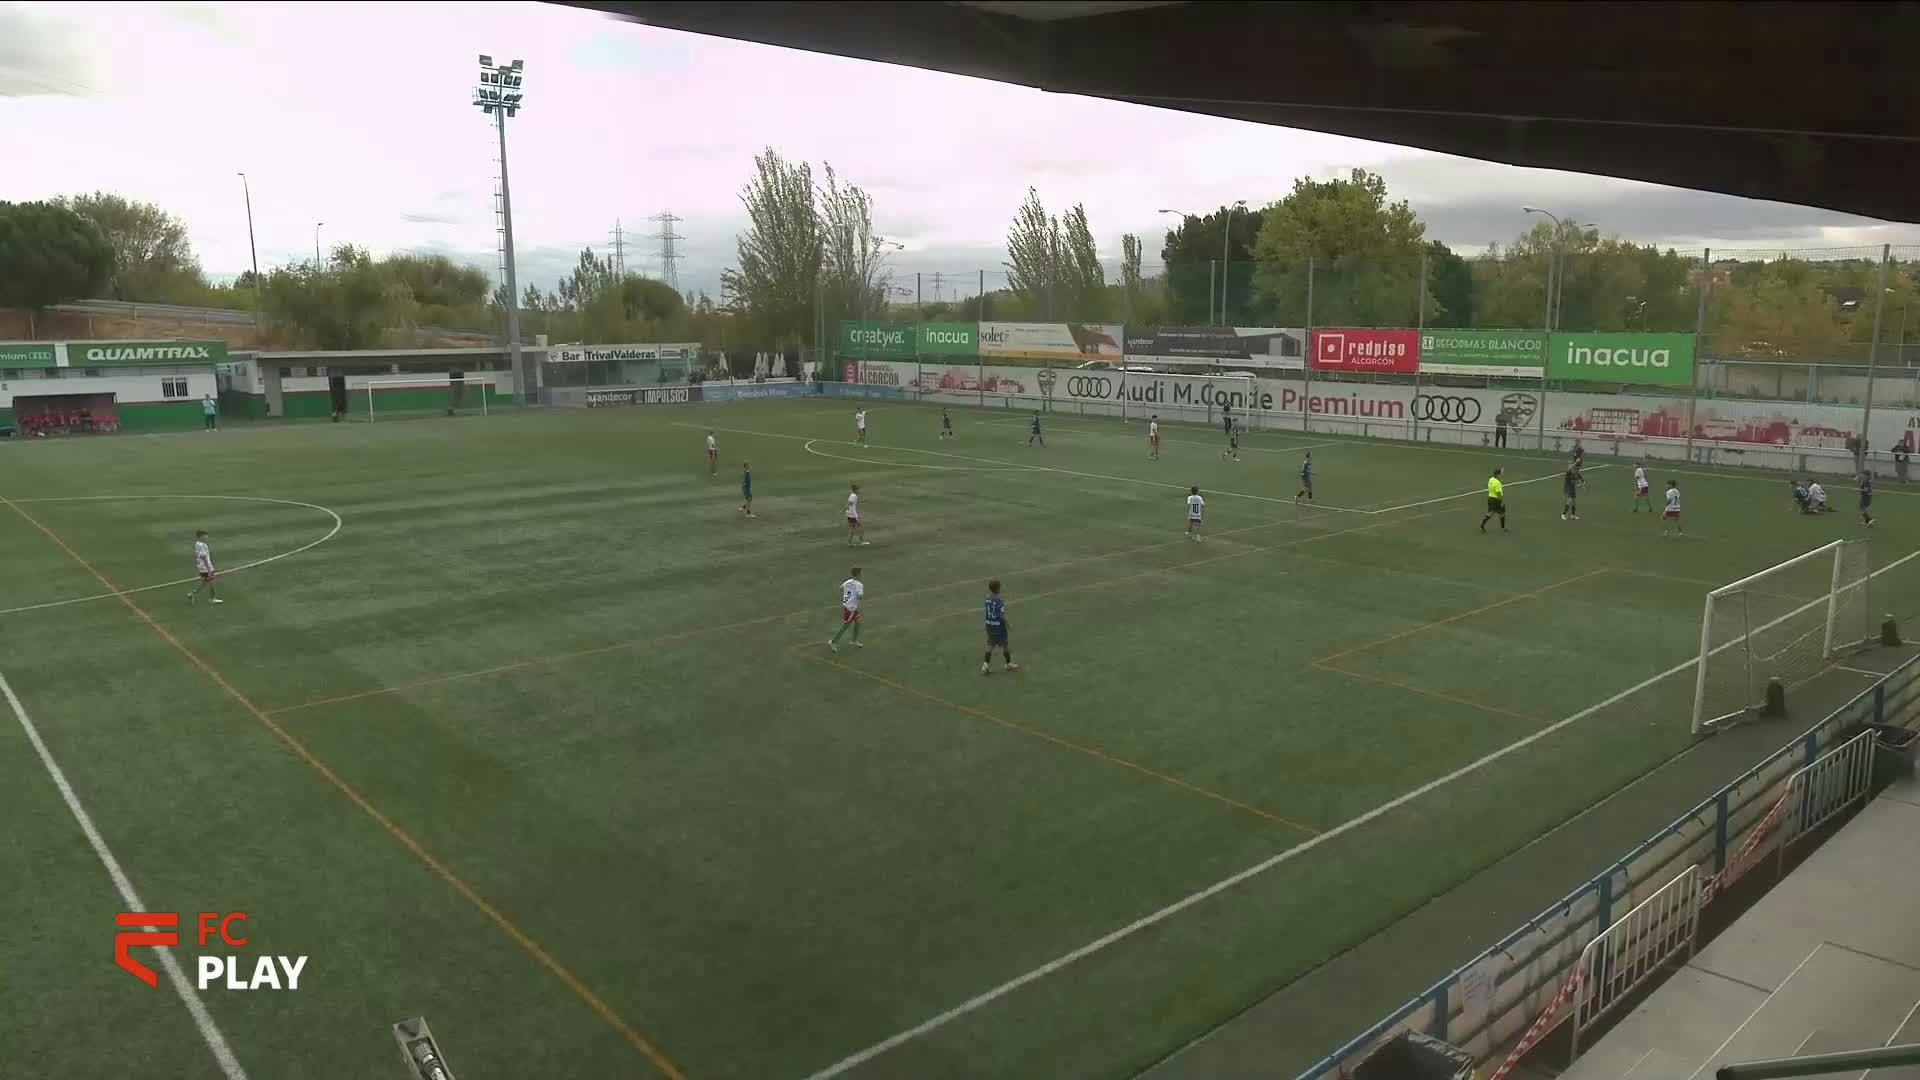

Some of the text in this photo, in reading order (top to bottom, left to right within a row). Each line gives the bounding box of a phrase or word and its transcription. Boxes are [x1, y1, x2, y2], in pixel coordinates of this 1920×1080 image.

[926, 328, 969, 344] inacua
[1435, 338, 1486, 349] REFORMAS
[86, 347, 209, 361] QUAMTRAX
[562, 350, 656, 361] Bar TrivalValderas
[1348, 340, 1405, 357] redpiso
[1567, 341, 1670, 368] inacua
[1351, 356, 1395, 366] ALCORCÓN
[1116, 381, 1404, 418] Audi M.Conde Premium
